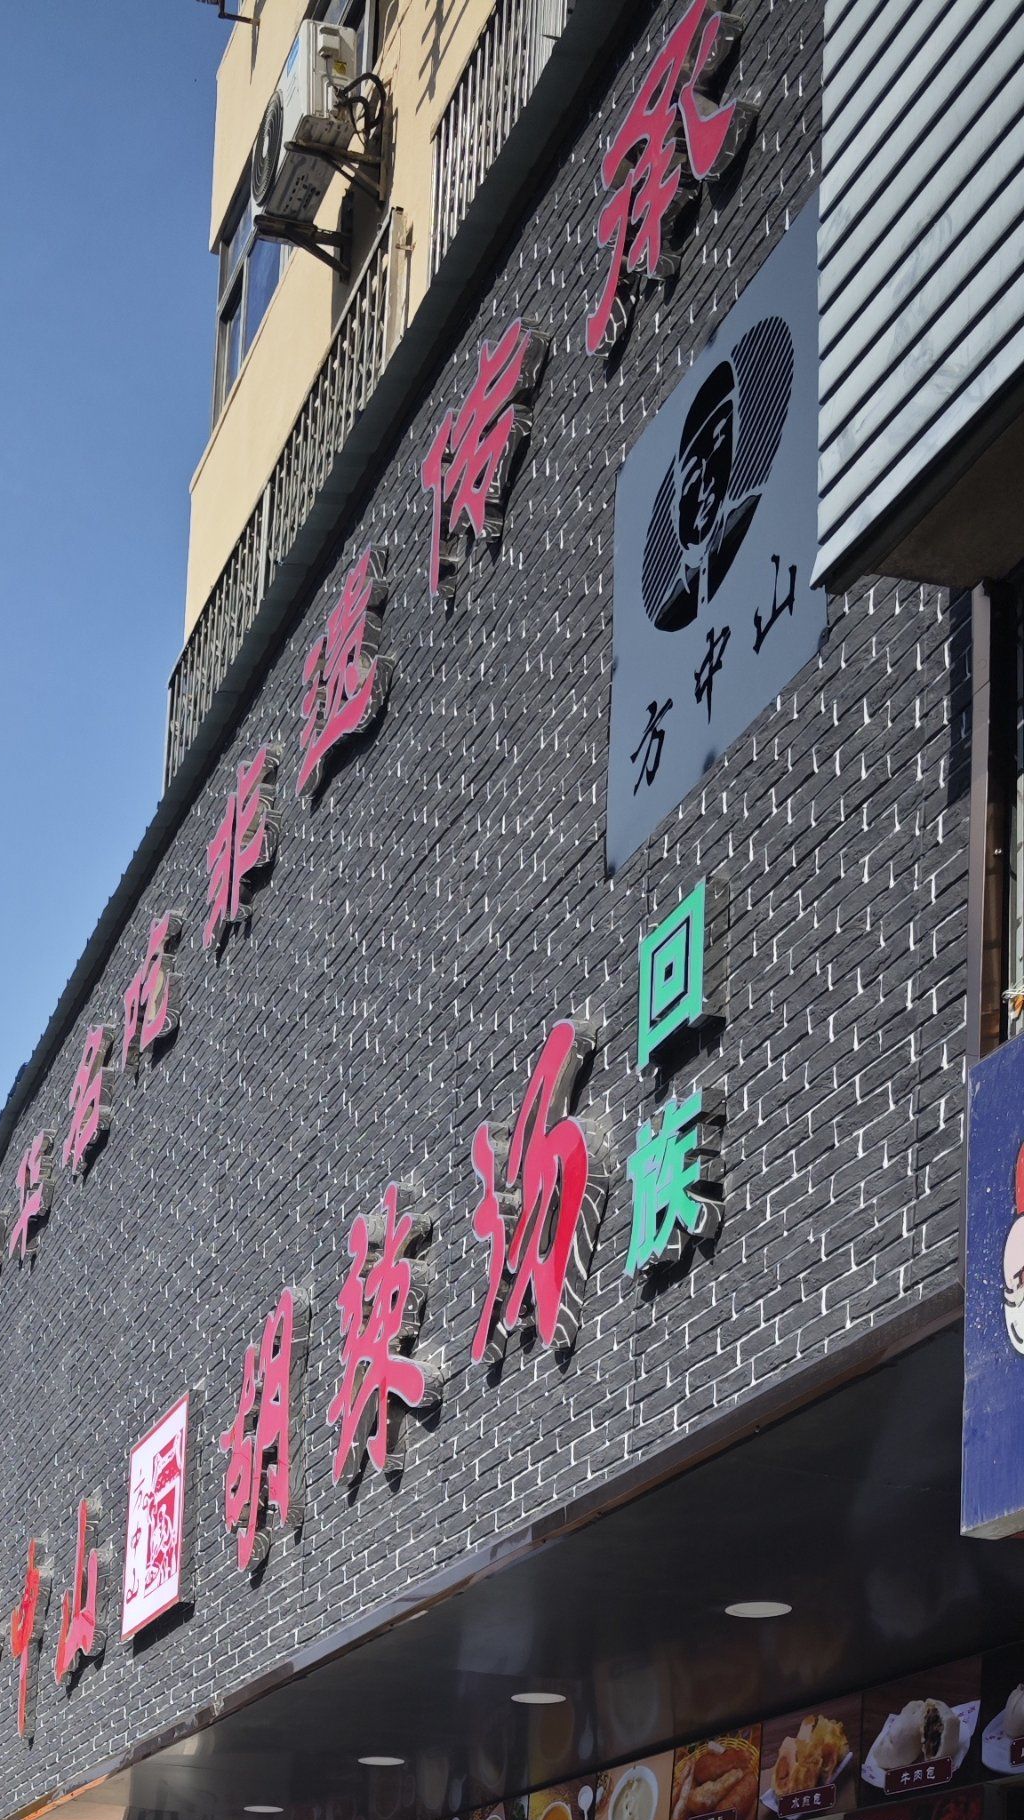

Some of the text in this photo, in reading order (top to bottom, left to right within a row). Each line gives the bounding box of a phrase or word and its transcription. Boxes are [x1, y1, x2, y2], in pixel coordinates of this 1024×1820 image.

[630, 554, 797, 796] 方中山
[624, 880, 706, 1276] 回族
[219, 1019, 588, 1571] 胡辣汤
[790, 1792, 823, 1809] 水煎包
[899, 1765, 937, 1785] 牛肉包
